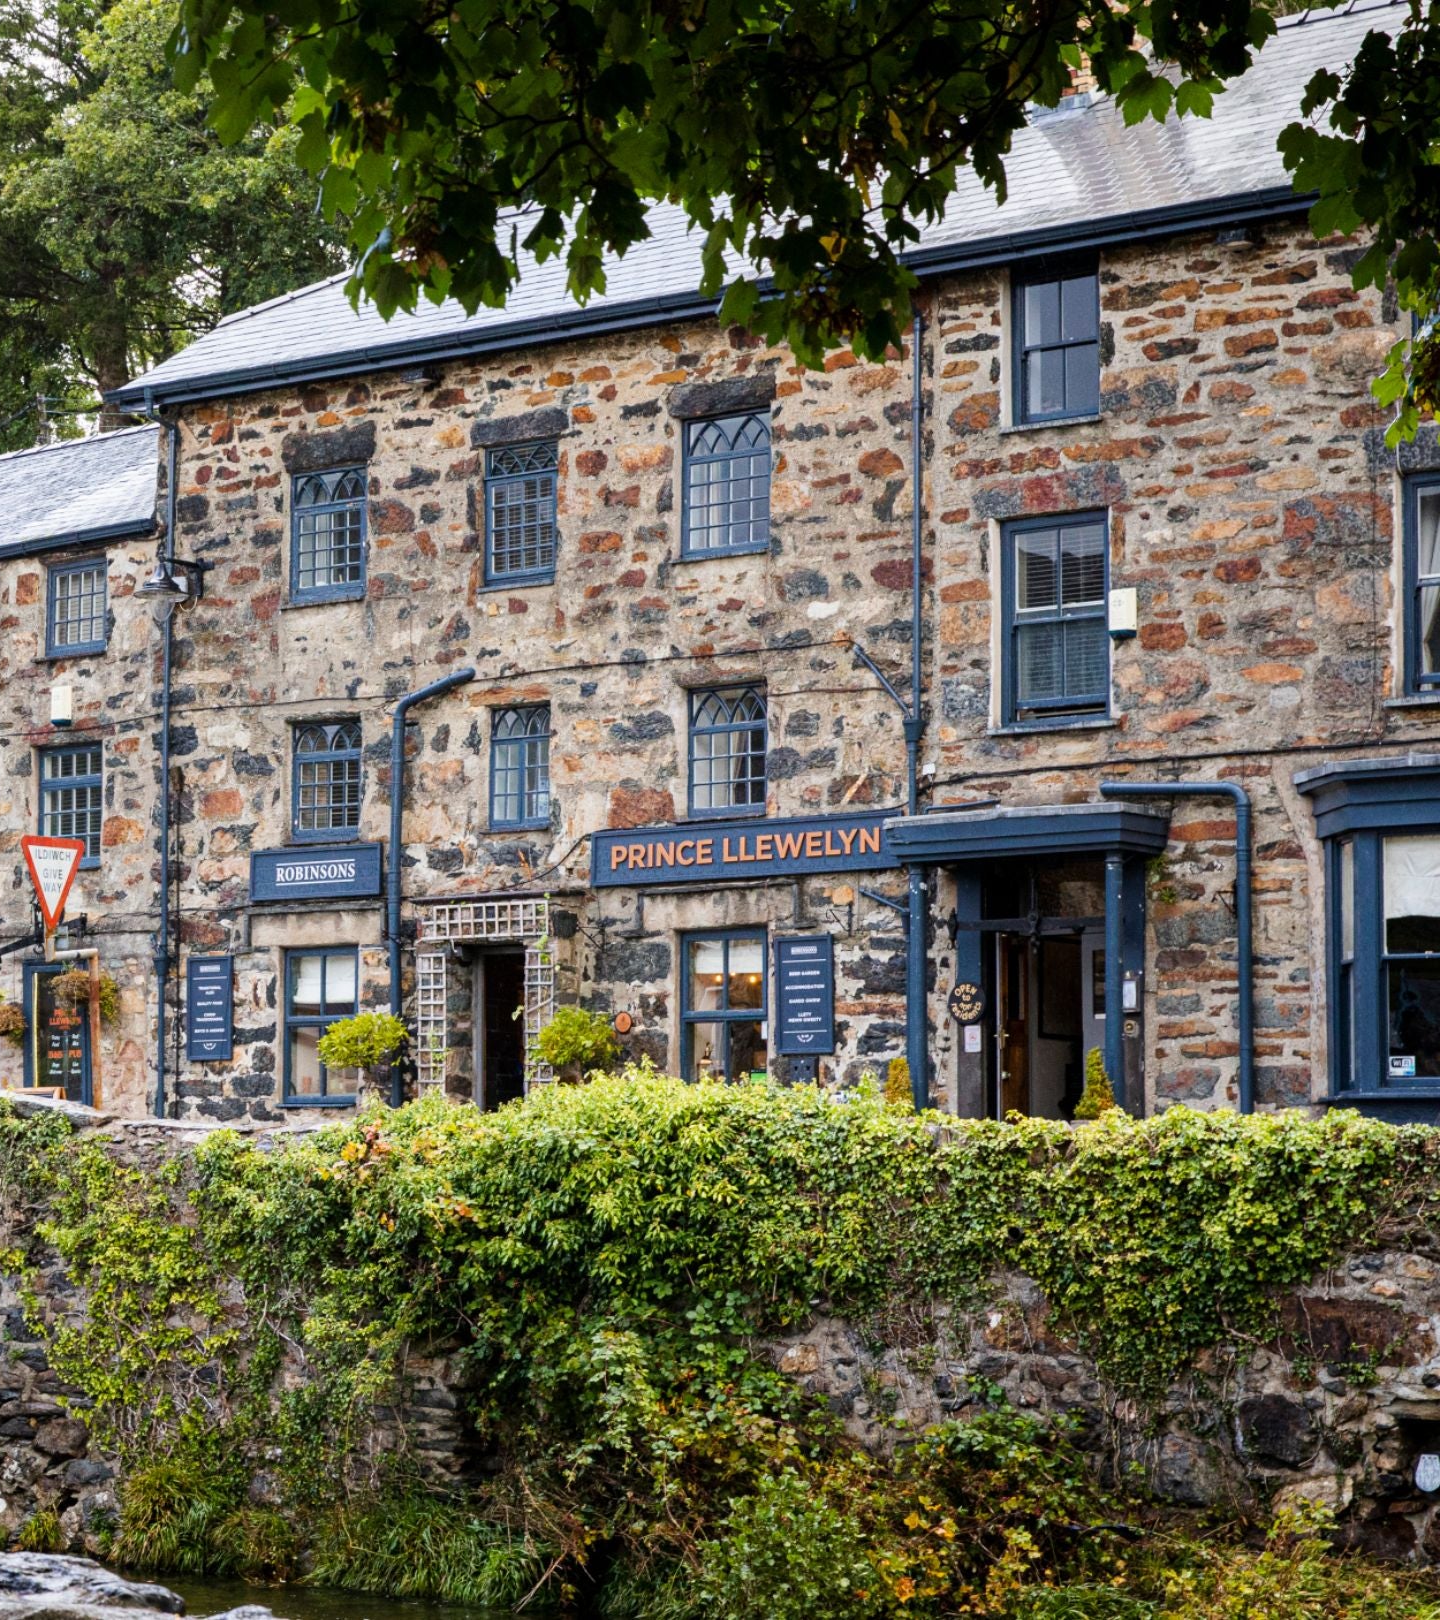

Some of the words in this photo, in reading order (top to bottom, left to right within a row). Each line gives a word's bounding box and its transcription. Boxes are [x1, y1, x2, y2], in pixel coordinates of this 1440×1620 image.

[35, 847, 72, 861] ILDIWCH
[611, 838, 713, 870] PRINCE
[722, 826, 881, 863] LLEWELYN
[42, 867, 64, 880] GIVE
[276, 862, 356, 882] ROBINSONS
[43, 881, 62, 893] WAY
[954, 983, 978, 997] OPEN
